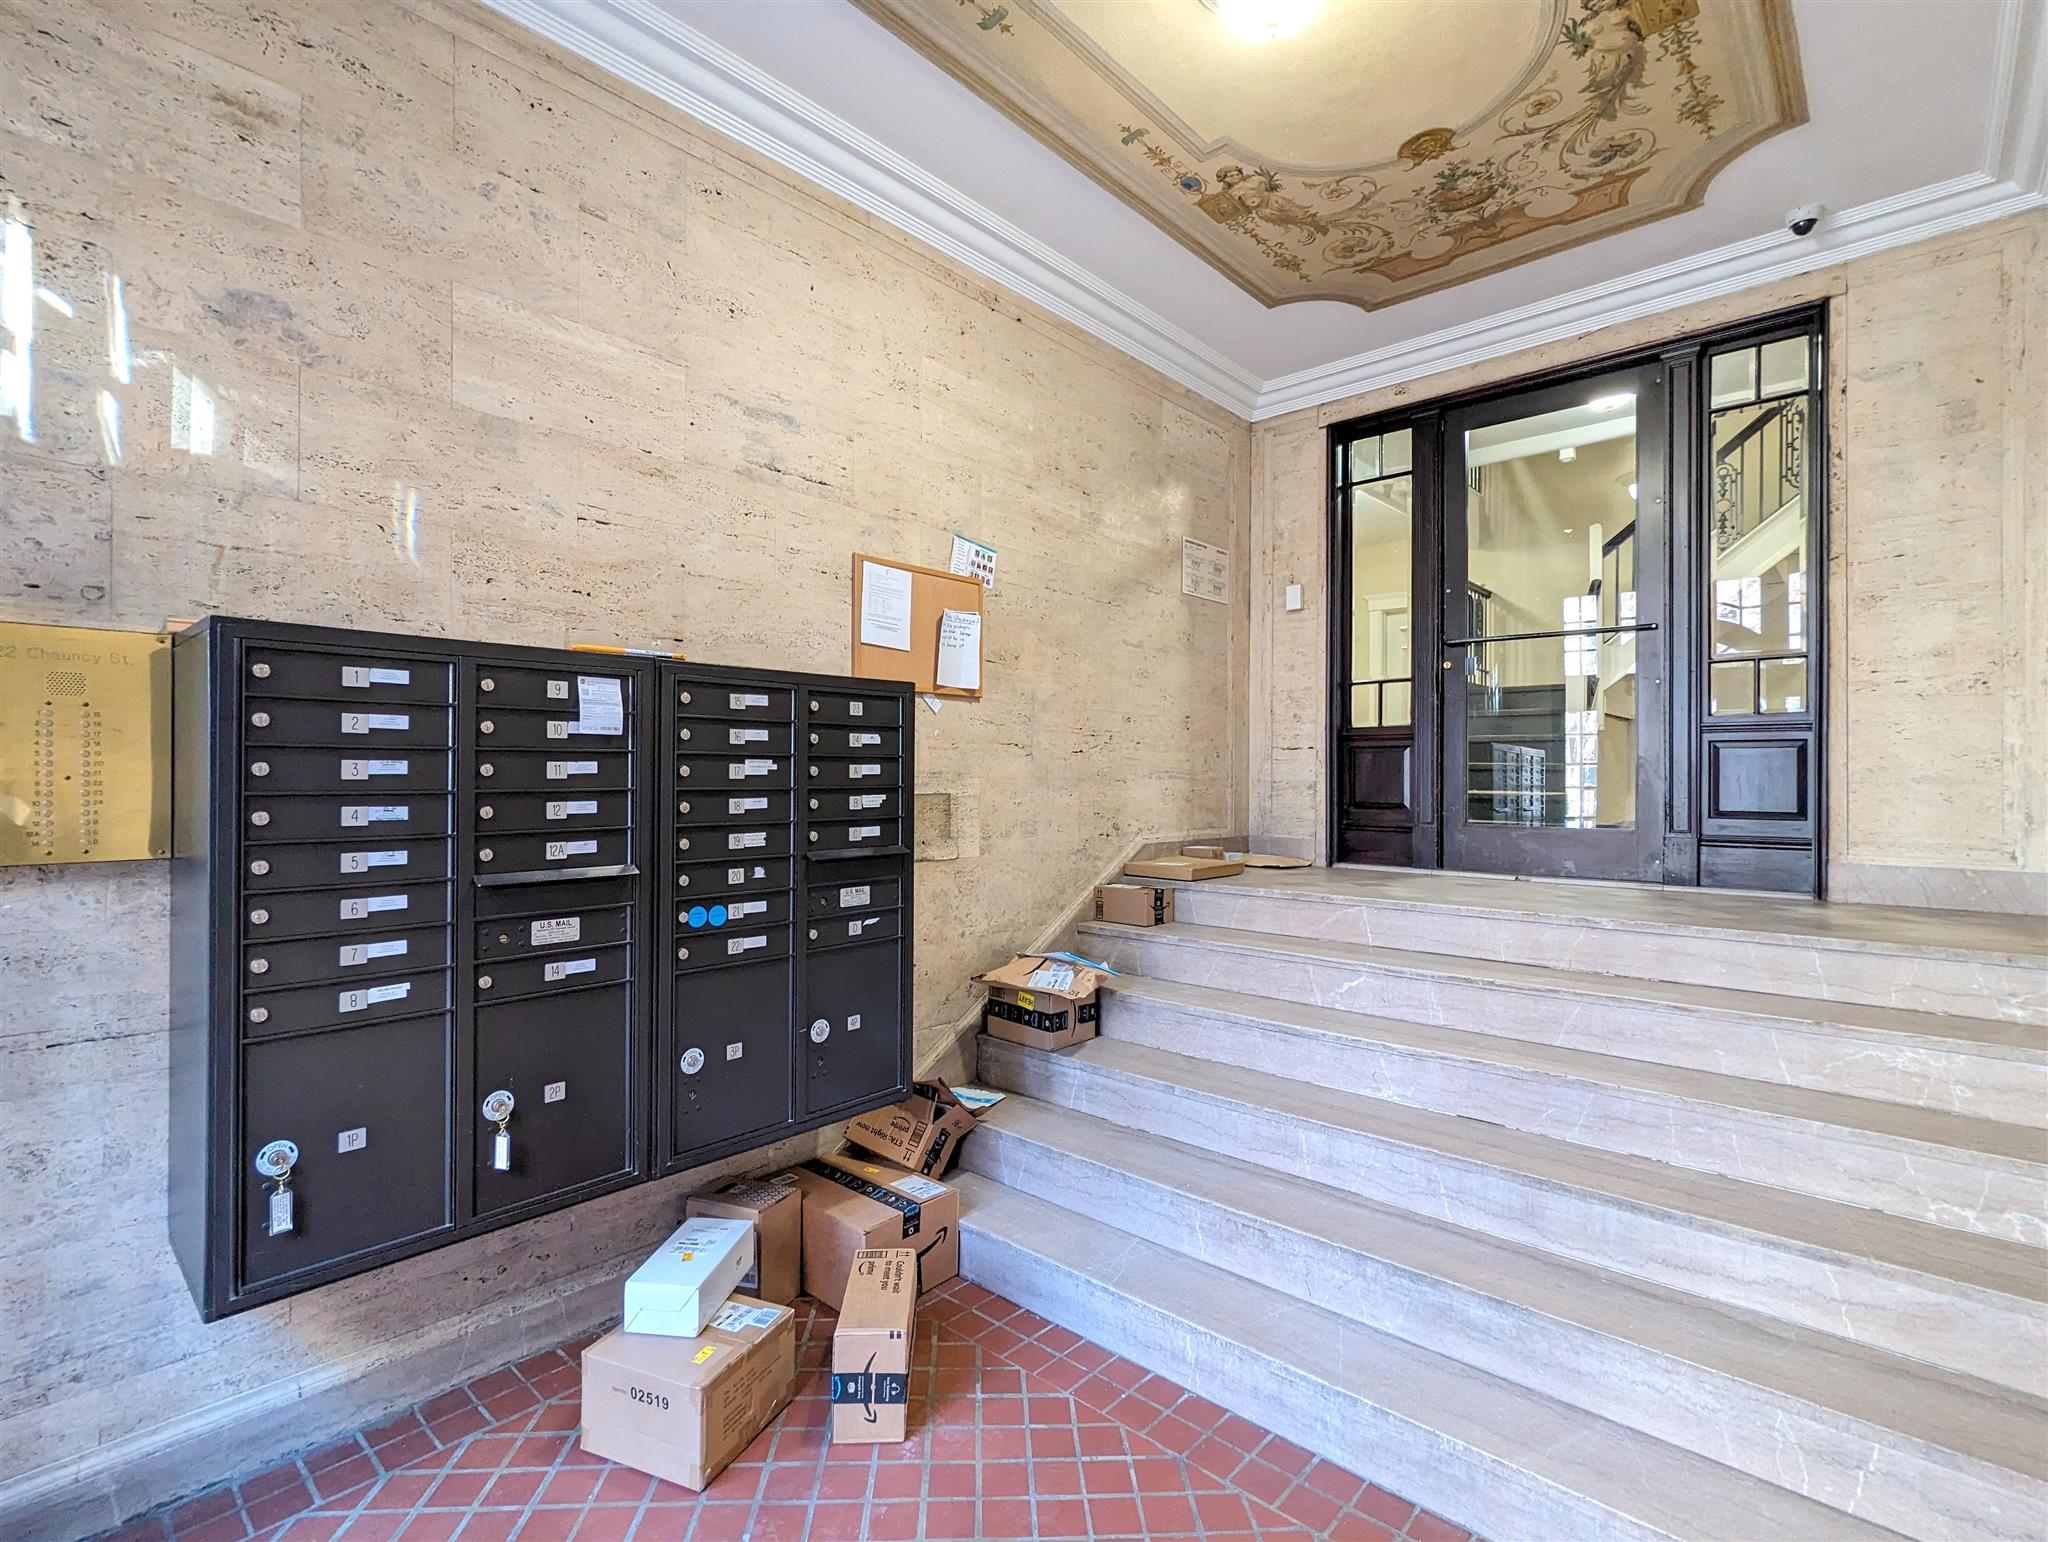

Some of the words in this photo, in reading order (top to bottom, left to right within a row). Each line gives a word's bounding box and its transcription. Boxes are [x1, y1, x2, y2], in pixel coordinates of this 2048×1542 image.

[27, 646, 101, 665] Chauncy
[110, 652, 134, 666] St.
[354, 670, 359, 684] 1
[555, 684, 561, 696] 9
[852, 704, 860, 714] 23
[352, 716, 359, 730] 2
[553, 724, 562, 736] 10
[852, 735, 860, 744] 24
[352, 762, 359, 776] 3
[554, 764, 561, 776] 11
[734, 766, 740, 776] 17
[853, 766, 859, 775] A
[853, 798, 858, 807] B
[351, 809, 358, 822] 4
[552, 804, 561, 816] 12
[733, 836, 740, 847] 19
[549, 844, 564, 857] 12A
[351, 856, 358, 870] 5
[731, 870, 741, 882] 20
[351, 902, 358, 916] 6
[732, 906, 740, 917] 21
[540, 921, 554, 929] U.S.
[853, 924, 858, 933] D
[731, 941, 740, 952] 22
[352, 948, 358, 962] 7
[551, 965, 560, 977] 14
[350, 994, 357, 1007] 8
[730, 1045, 740, 1057] 3P
[490, 1092, 506, 1101] OPEN
[549, 1086, 560, 1099] 2P
[856, 1122, 870, 1131] now
[890, 1122, 910, 1133] prime
[347, 1132, 358, 1147] 1P
[871, 1127, 888, 1140] Right
[266, 1142, 288, 1152] OPEN
[890, 1135, 904, 1148] ETA:
[867, 1261, 876, 1275] prime
[894, 1261, 904, 1281] Couldn't
[880, 1280, 888, 1290] you
[892, 1282, 901, 1294] wait
[630, 1386, 669, 1410] 02519
